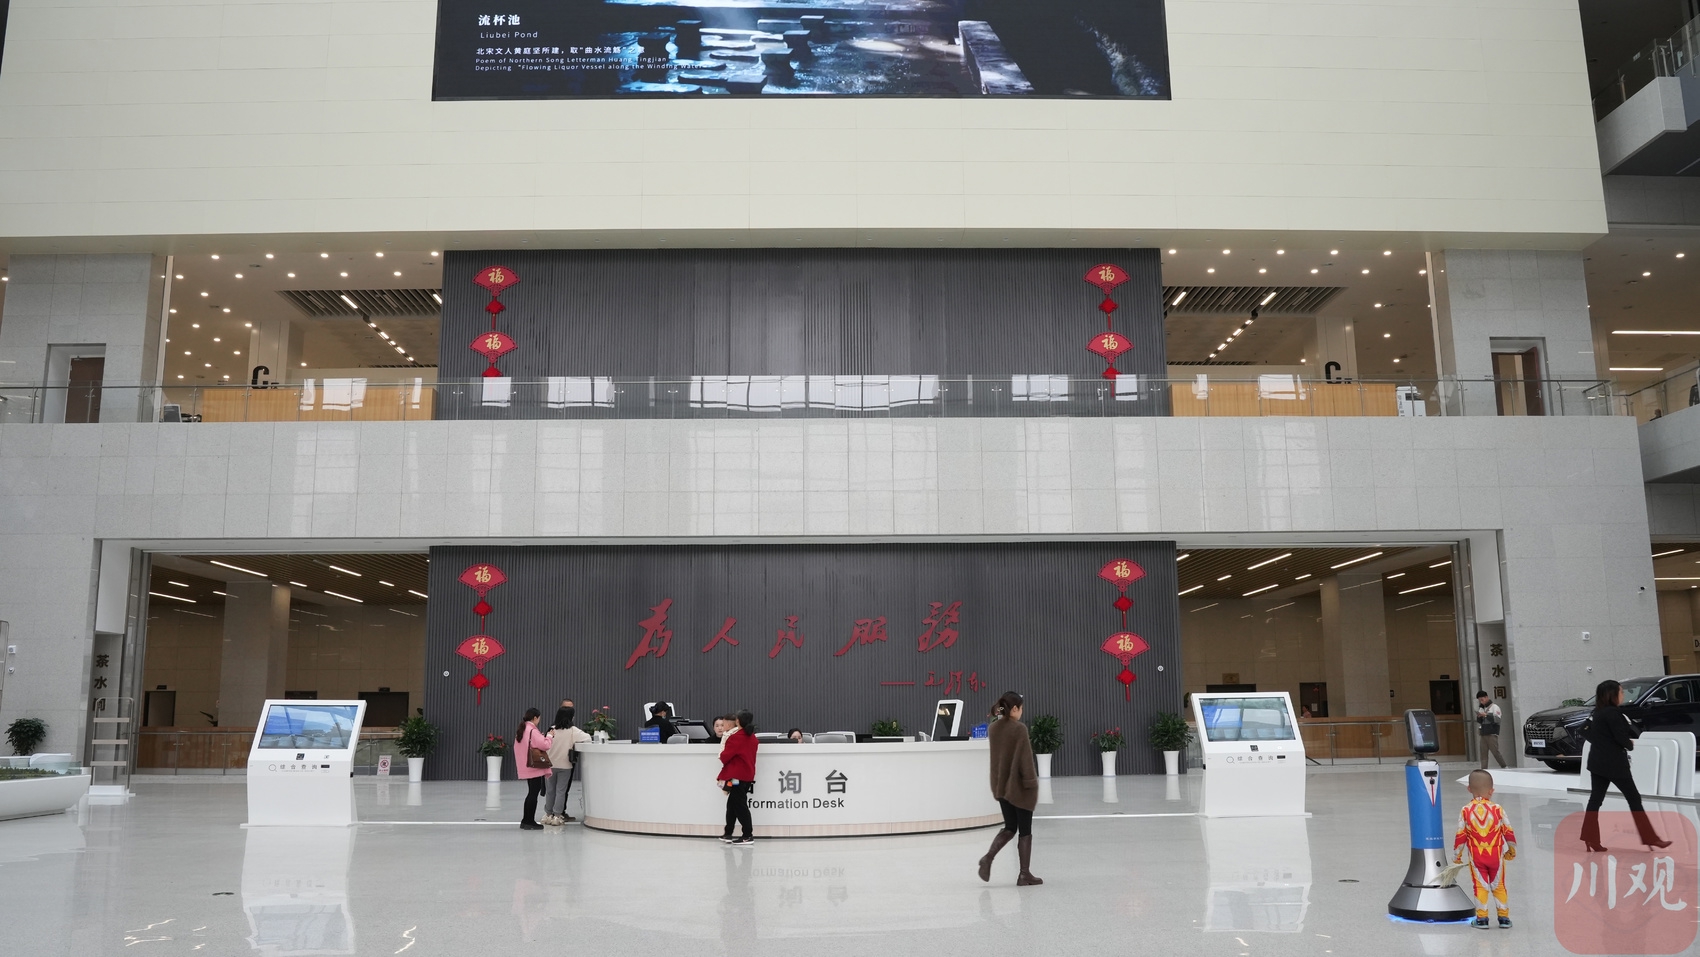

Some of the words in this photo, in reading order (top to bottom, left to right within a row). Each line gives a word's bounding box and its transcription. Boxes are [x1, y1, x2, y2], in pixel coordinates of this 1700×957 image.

[478, 14, 521, 27] 流杯池
[480, 31, 511, 39] Liubei
[514, 31, 539, 39] Pond
[608, 63, 630, 71] along
[647, 63, 678, 71] Winding
[636, 56, 667, 64] Tingjian
[488, 268, 505, 284] 福
[1098, 266, 1115, 282] 福
[485, 334, 502, 350] 福
[1101, 334, 1118, 350] 福
[474, 566, 492, 583] 福
[1113, 561, 1131, 578] 福
[471, 638, 489, 655] 福
[1116, 634, 1134, 651] 福
[1490, 643, 1507, 700] 茶水间
[92, 654, 110, 712] 茶水间
[747, 769, 848, 794] 询台
[747, 797, 809, 809] formation
[812, 797, 845, 809] Desk
